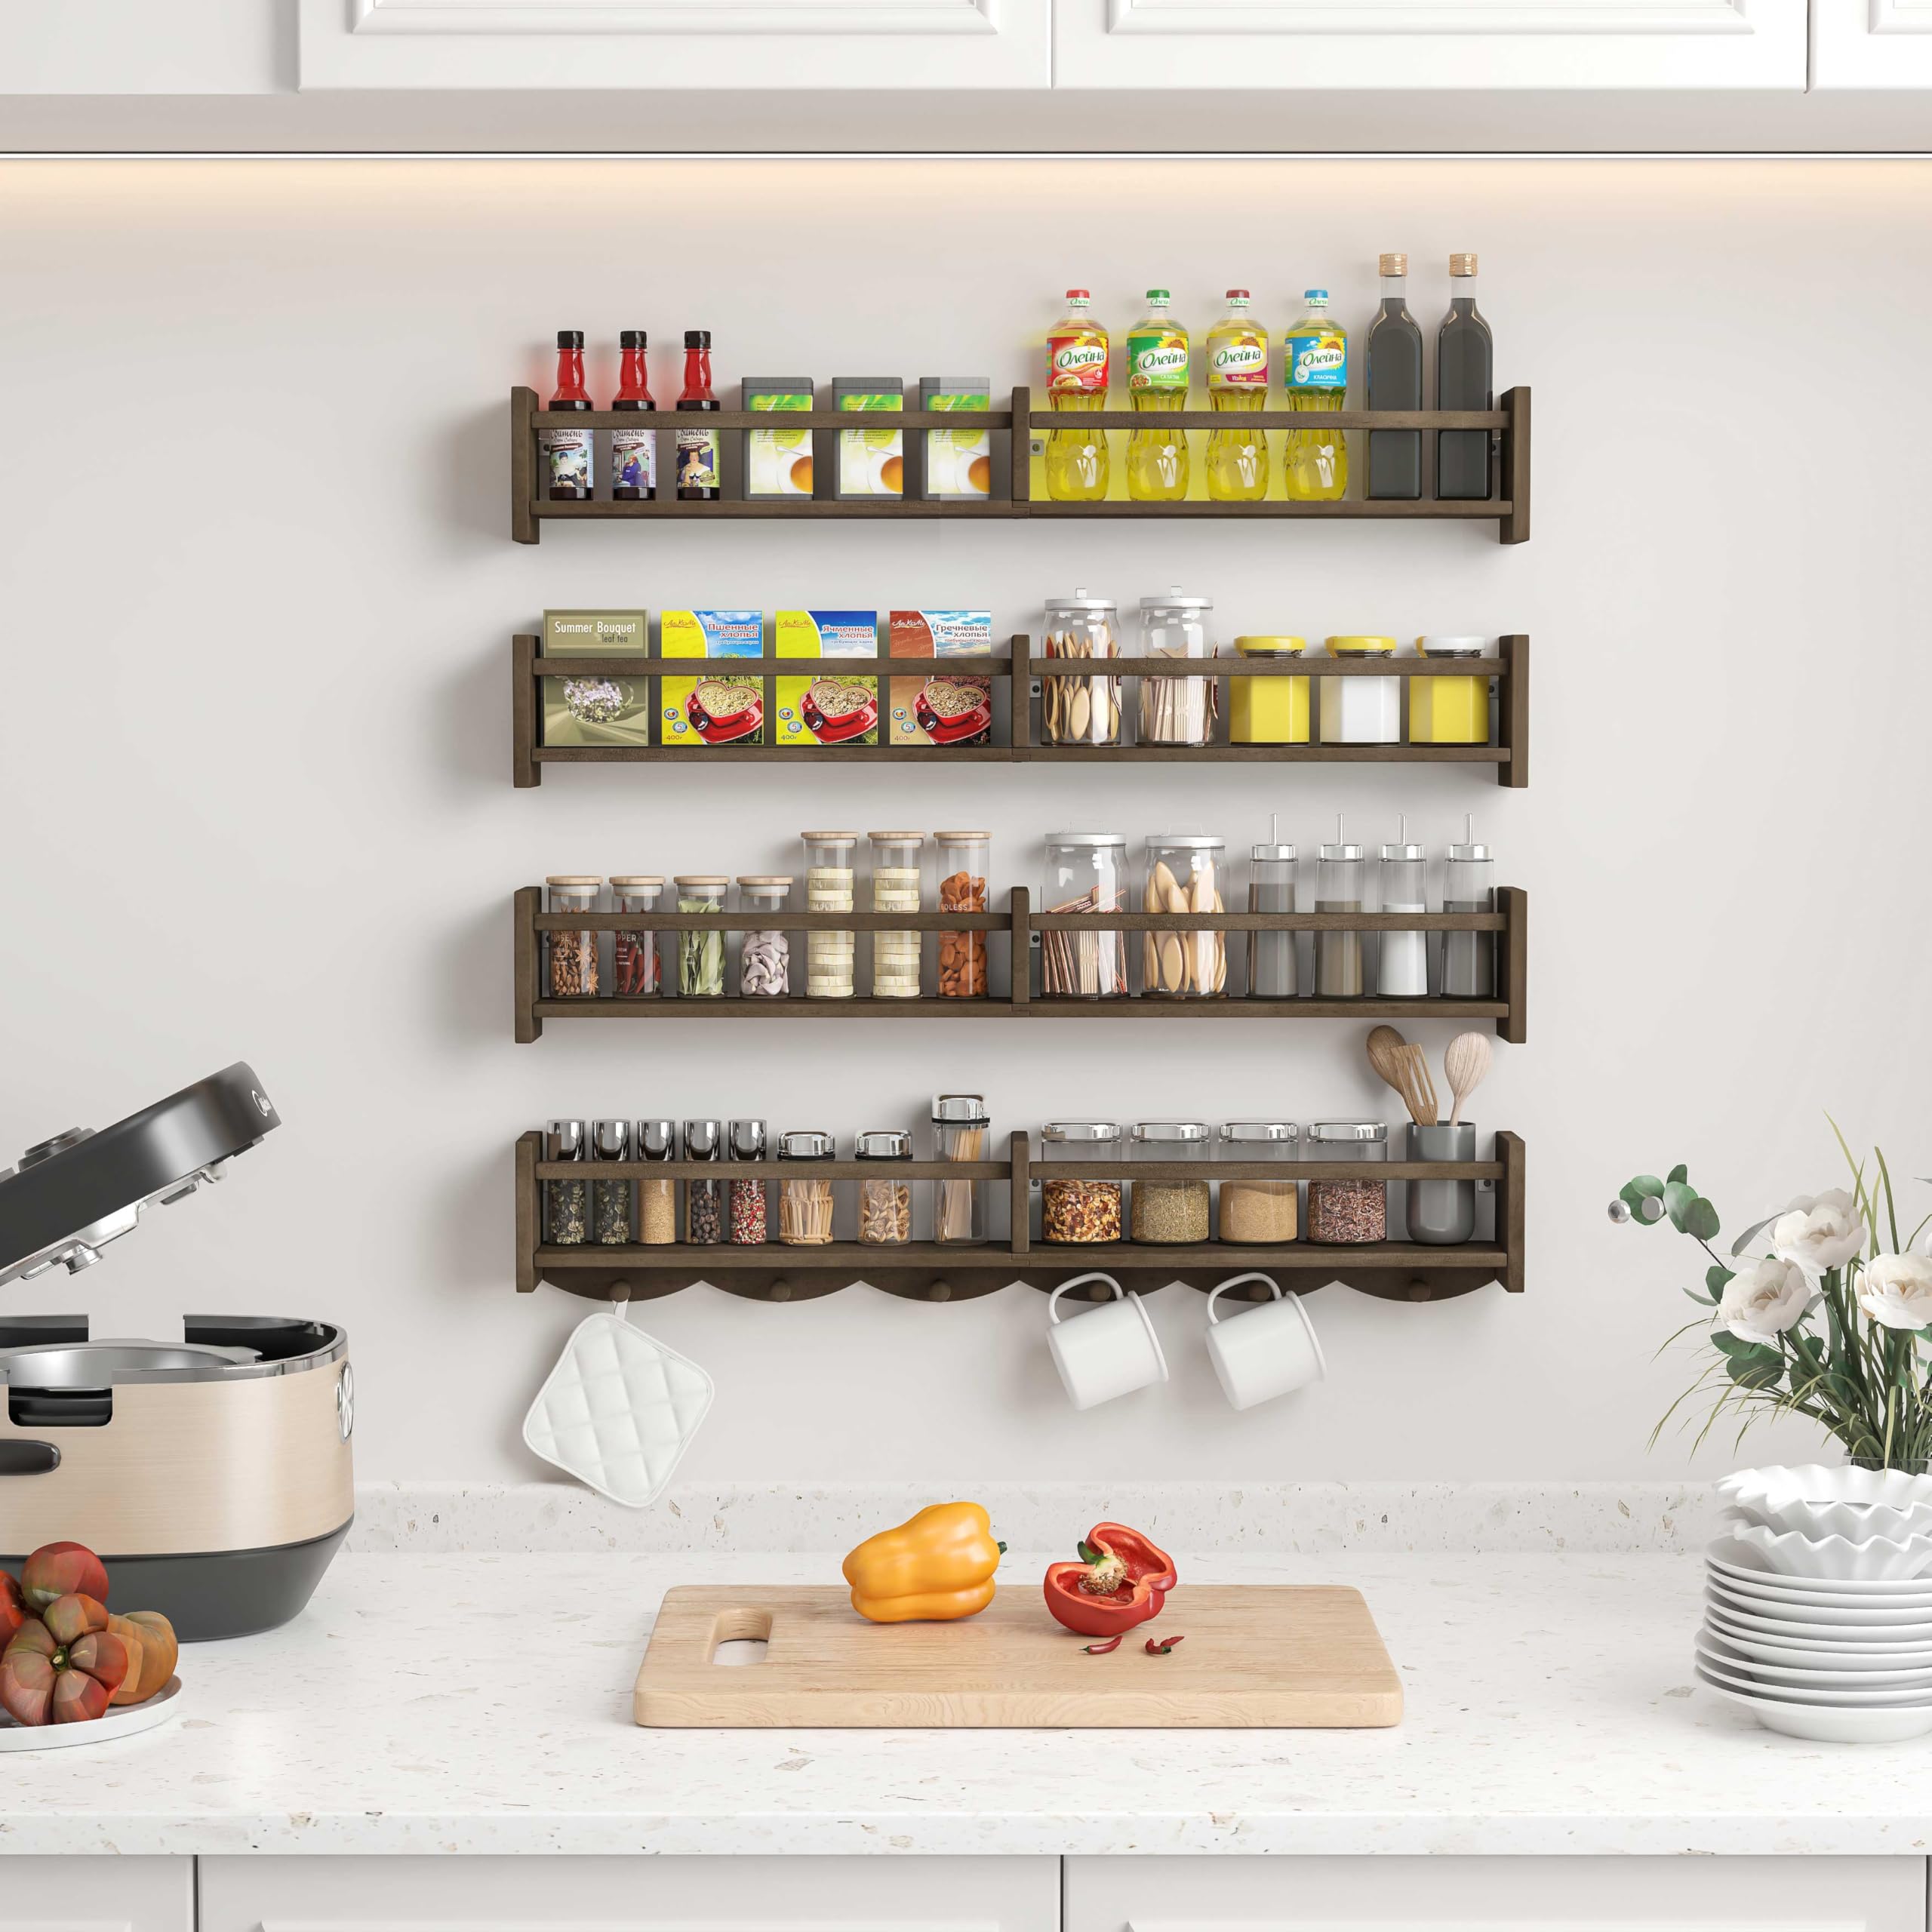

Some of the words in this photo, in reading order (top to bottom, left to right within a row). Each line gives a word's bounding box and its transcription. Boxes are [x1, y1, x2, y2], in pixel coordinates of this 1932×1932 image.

[1060, 351, 1104, 368] Олейна
[1143, 352, 1186, 369] Олейна
[1217, 350, 1260, 366] Олейна
[1303, 352, 1342, 367] Олейна
[555, 621, 593, 633] Summer
[597, 621, 636, 635] Bouquet
[936, 624, 987, 632] Гречневые
[601, 634, 614, 643] leaf
[617, 635, 628, 643] tea
